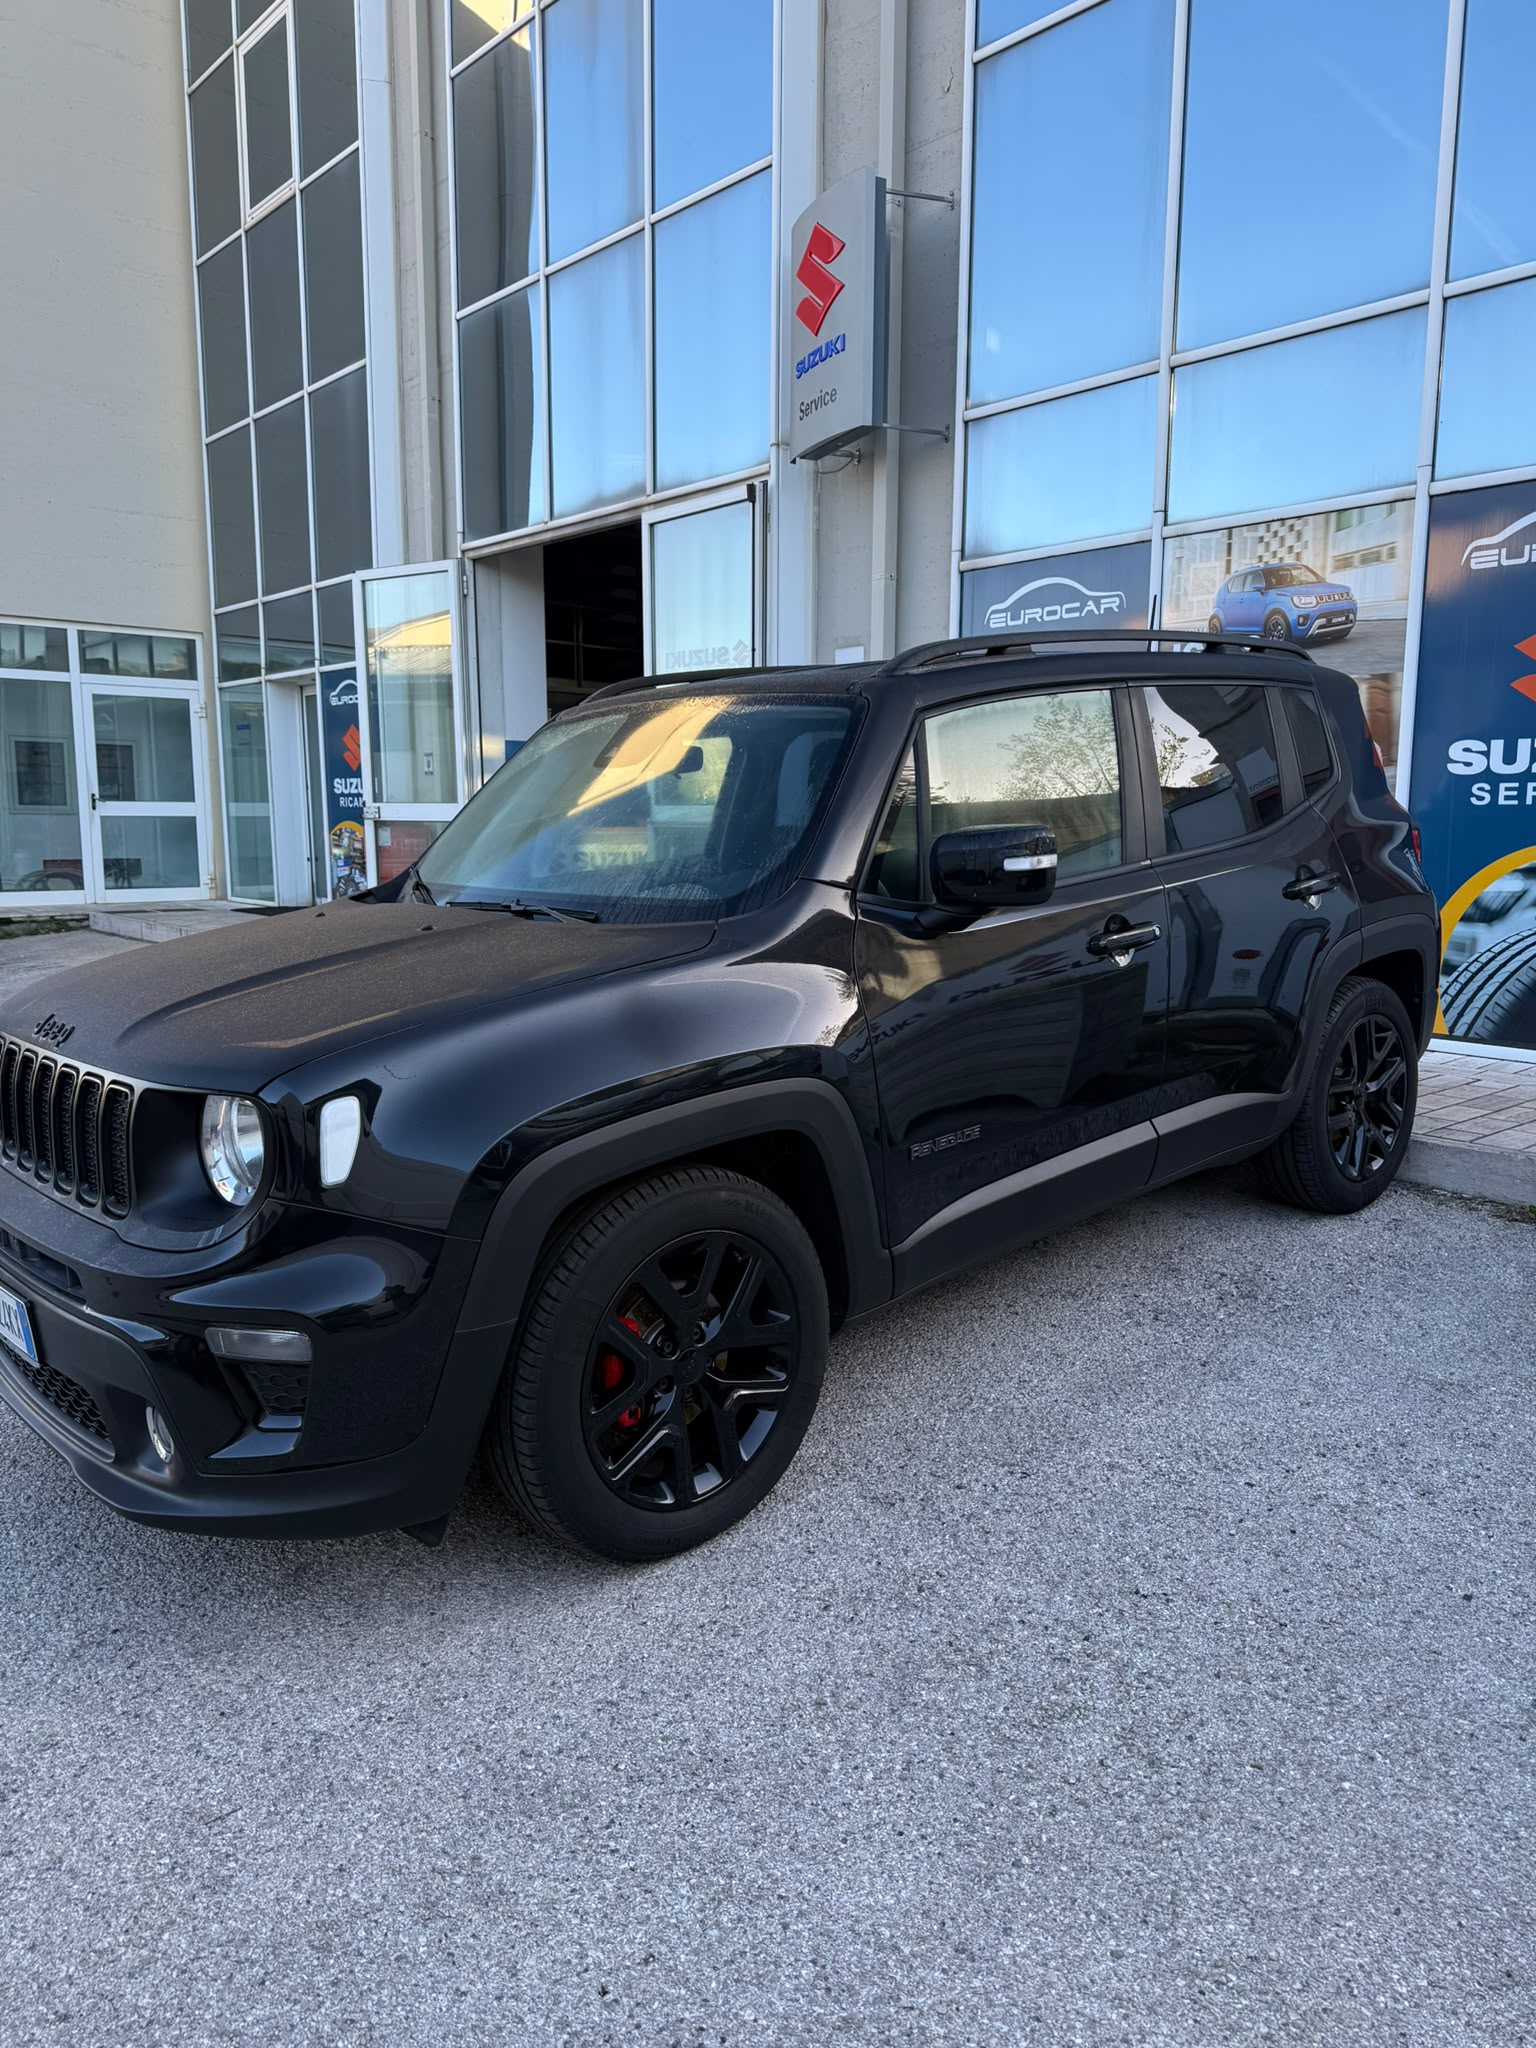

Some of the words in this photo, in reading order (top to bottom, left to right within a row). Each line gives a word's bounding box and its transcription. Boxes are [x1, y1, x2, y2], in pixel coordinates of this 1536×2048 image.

[795, 333, 846, 380] SUZUKI
[799, 387, 838, 421] Service
[1470, 543, 1536, 570] EU
[989, 596, 1120, 629] EUROCAR
[1446, 737, 1536, 776] SU
[33, 1012, 76, 1048] Jeep
[909, 1123, 982, 1161] RENEGADE
